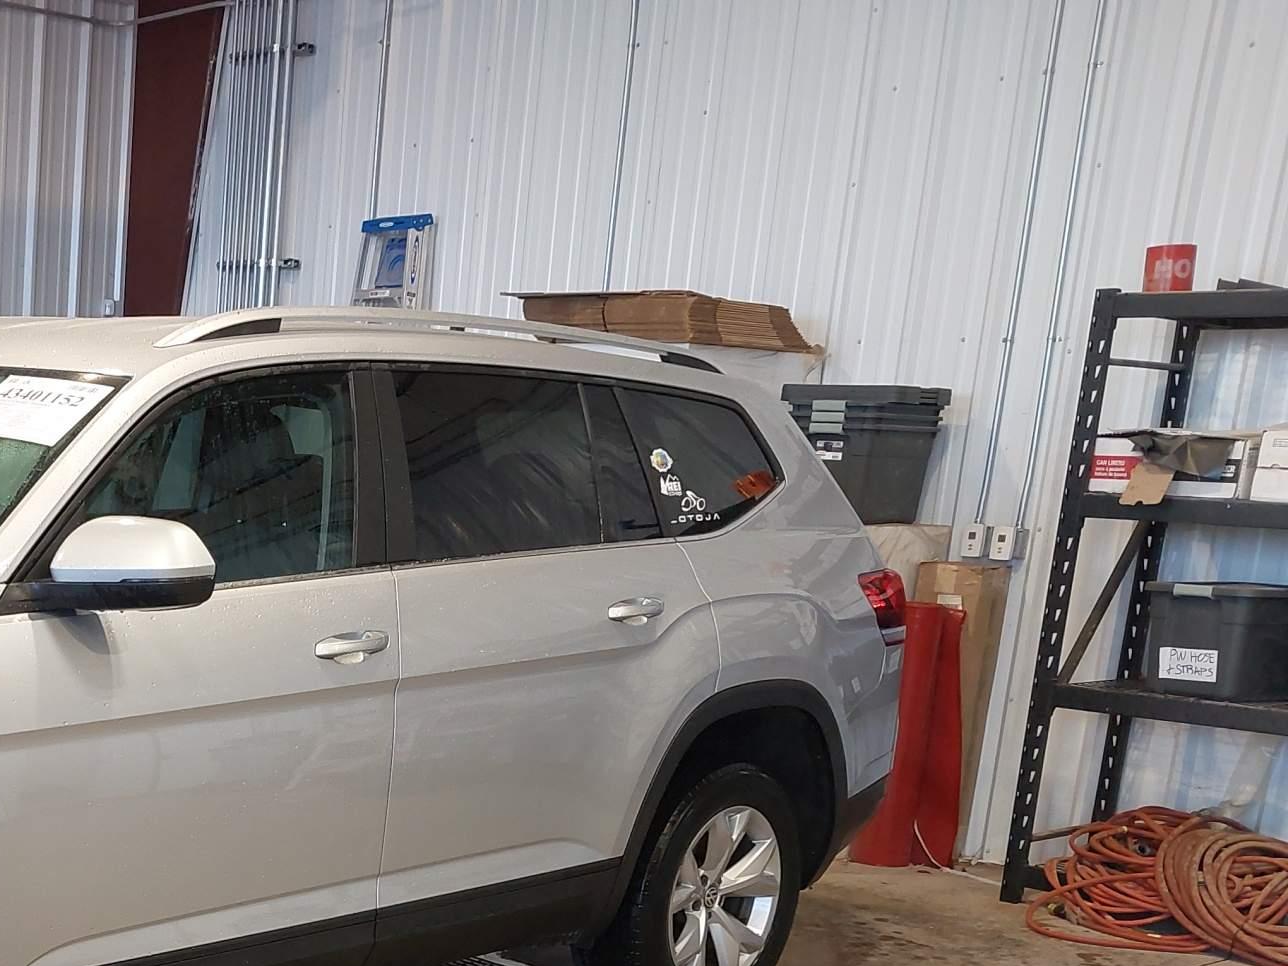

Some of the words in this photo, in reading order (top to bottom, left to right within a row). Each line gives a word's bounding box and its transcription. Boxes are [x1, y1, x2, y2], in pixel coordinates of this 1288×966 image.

[0, 387, 85, 407] 43401152
[1169, 648, 1187, 662] PW
[1190, 651, 1216, 664] HOSE
